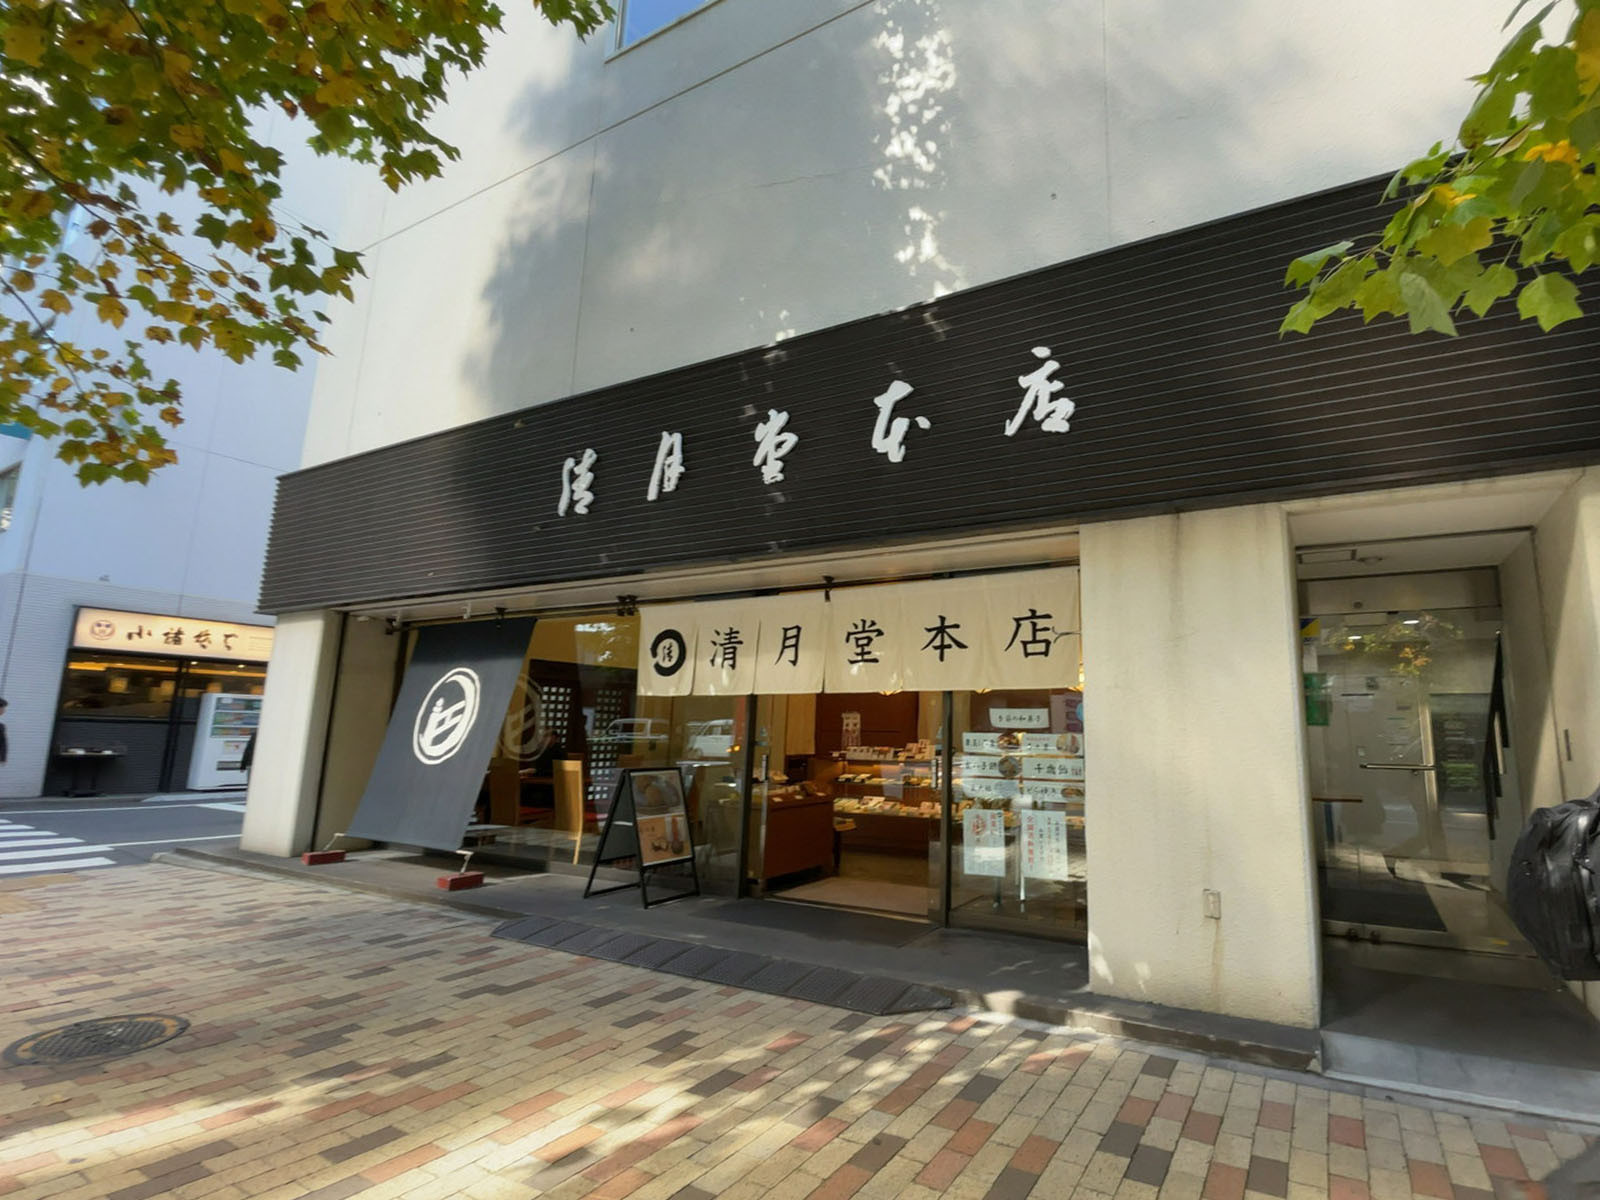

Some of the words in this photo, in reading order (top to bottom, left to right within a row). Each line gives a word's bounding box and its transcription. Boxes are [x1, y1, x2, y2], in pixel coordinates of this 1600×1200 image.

[557, 346, 1076, 516] 清月堂本店
[709, 608, 1054, 670] 清月堂本店
